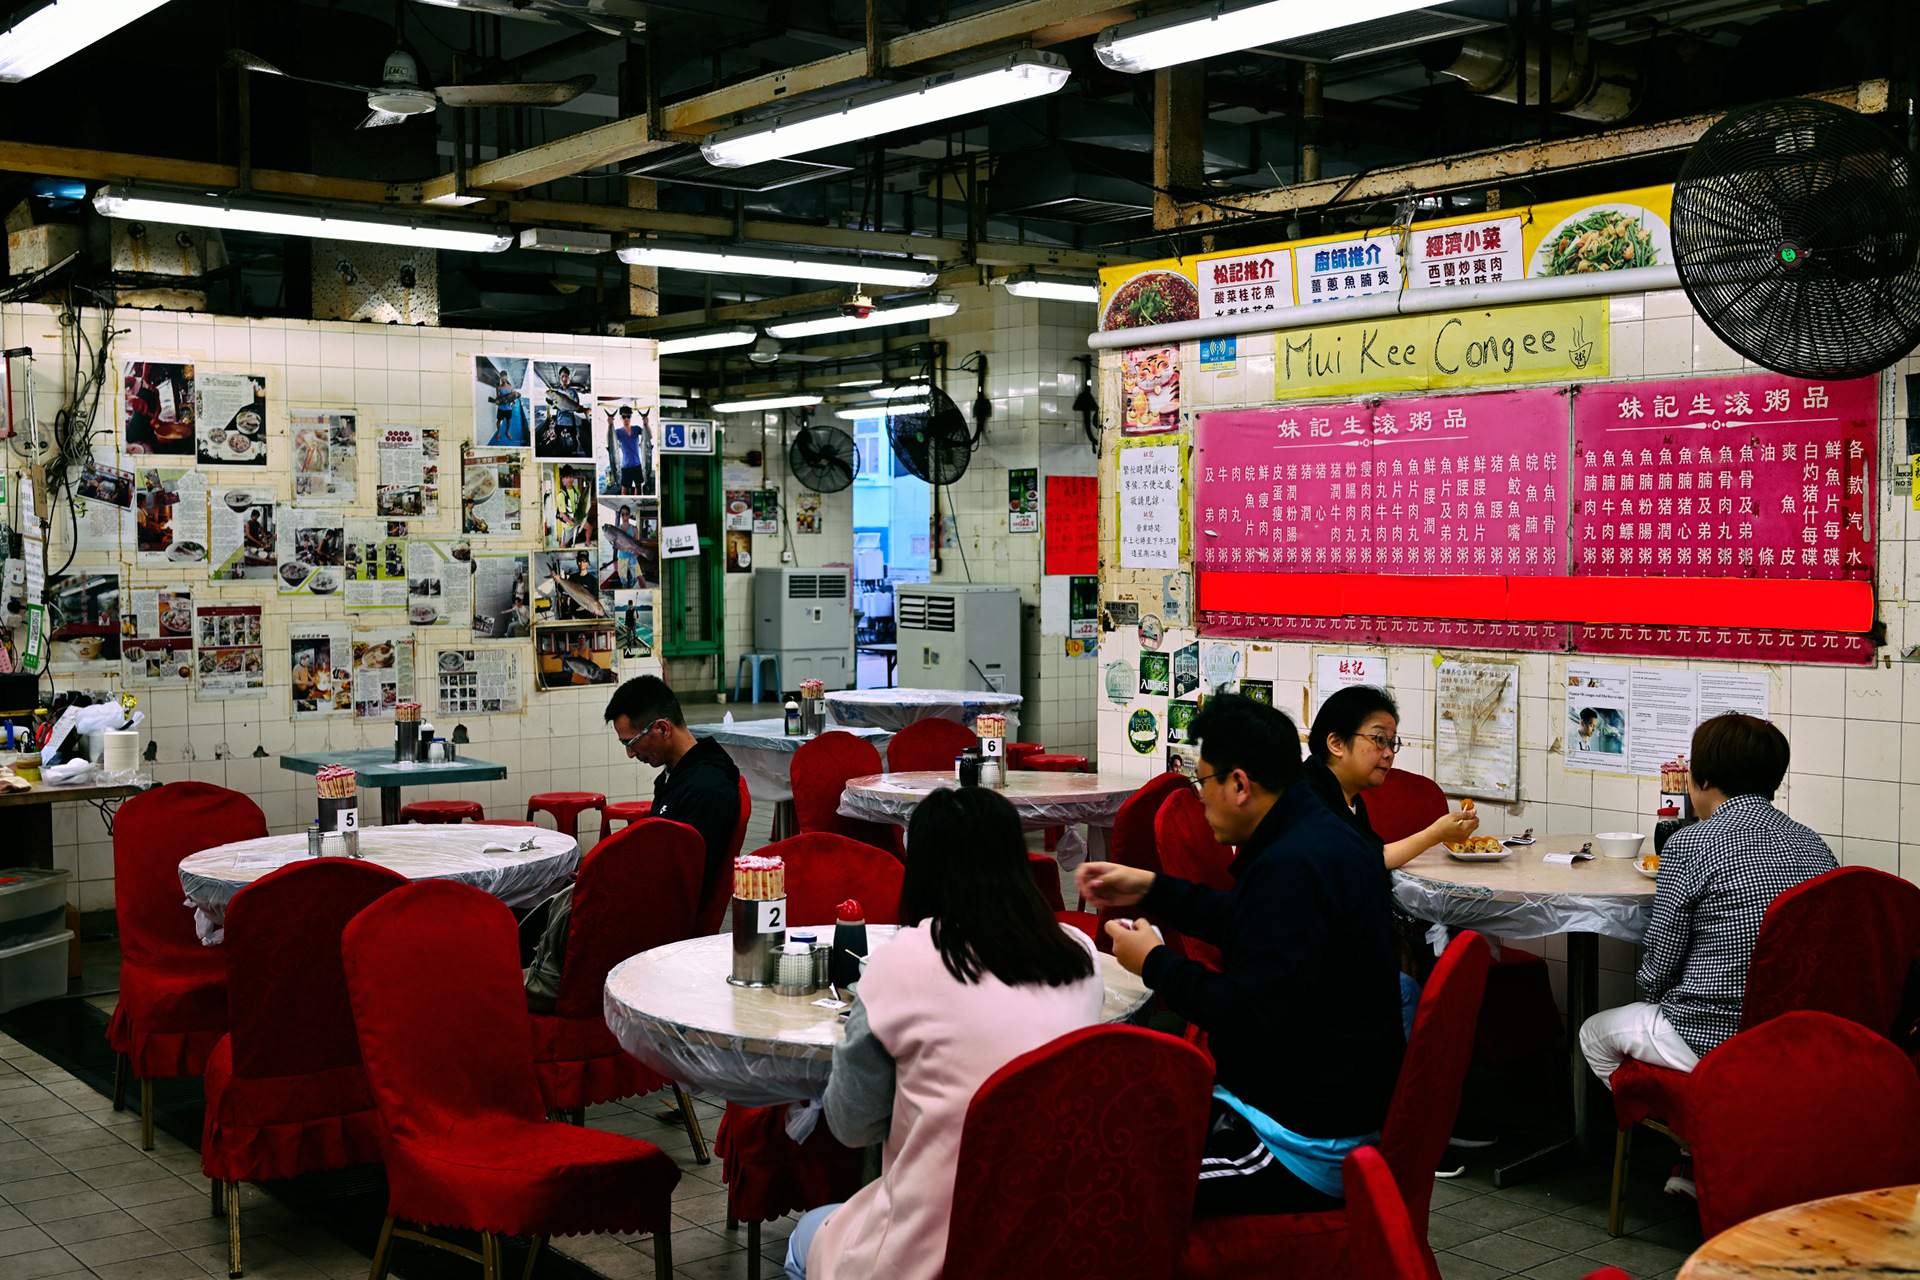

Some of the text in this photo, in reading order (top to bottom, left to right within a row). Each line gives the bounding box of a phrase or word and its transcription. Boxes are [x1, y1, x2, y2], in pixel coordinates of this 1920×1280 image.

[1425, 226, 1502, 258] 經濟小菜
[1314, 243, 1382, 273] 廚師推介
[1213, 258, 1275, 285] 松記推介
[1428, 256, 1502, 279] 西蘭炒爽肉
[1214, 285, 1275, 305] 酸菜桂花魚
[1286, 318, 1556, 380] Mui Kee Congee
[1583, 622, 1596, 639] 元
[1601, 623, 1615, 639] 元
[1620, 623, 1633, 640] 元
[1638, 624, 1652, 641] 元
[1657, 625, 1671, 642] 元
[1677, 626, 1691, 642] 元
[1697, 627, 1711, 643] 元
[1717, 627, 1731, 644] 元
[1738, 628, 1753, 645] 元
[1759, 629, 1774, 645] 元
[1781, 630, 1796, 646] 元
[1802, 631, 1818, 647] 元
[1824, 632, 1840, 648] 元
[1846, 632, 1862, 649] 元
[1338, 660, 1364, 676] 妹記
[820, 702, 824, 710] 7
[988, 740, 996, 752] 6
[346, 812, 354, 826] 5
[769, 907, 780, 927] 2
